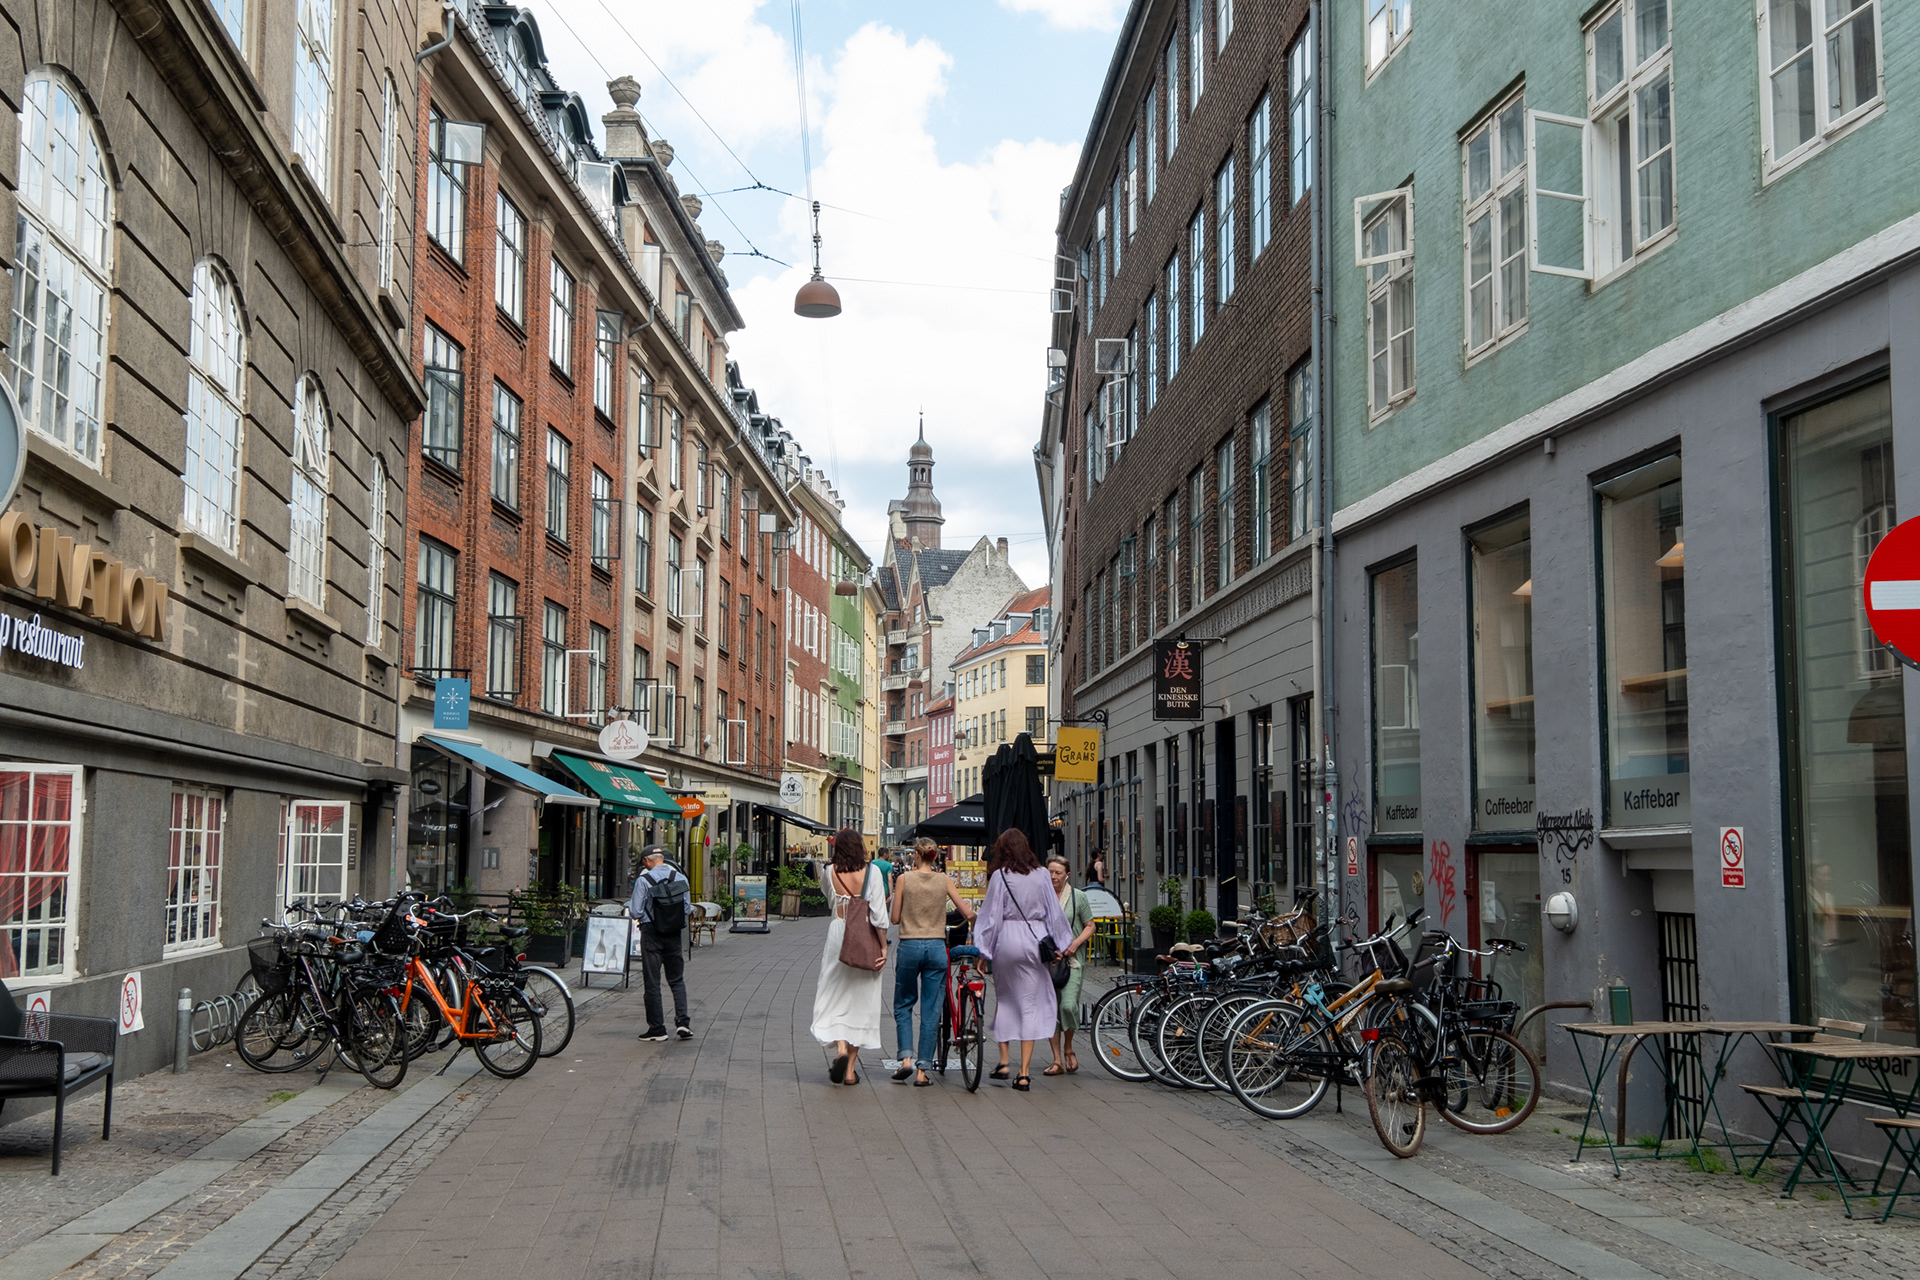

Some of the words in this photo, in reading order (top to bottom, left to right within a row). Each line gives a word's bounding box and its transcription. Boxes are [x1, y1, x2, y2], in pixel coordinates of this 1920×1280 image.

[12, 613, 84, 670] restaurant
[1164, 649, 1192, 680] 漢
[1158, 693, 1199, 701] KINESISKE
[1170, 686, 1187, 694] DEN
[1059, 746, 1095, 765] GRAMS
[1083, 741, 1096, 751] 20
[1485, 797, 1533, 816] Coffeebar
[1623, 788, 1680, 811] Kaffebar
[1385, 804, 1418, 820] Kaffebar
[1574, 808, 1593, 827] Nails
[1561, 867, 1572, 884] 15
